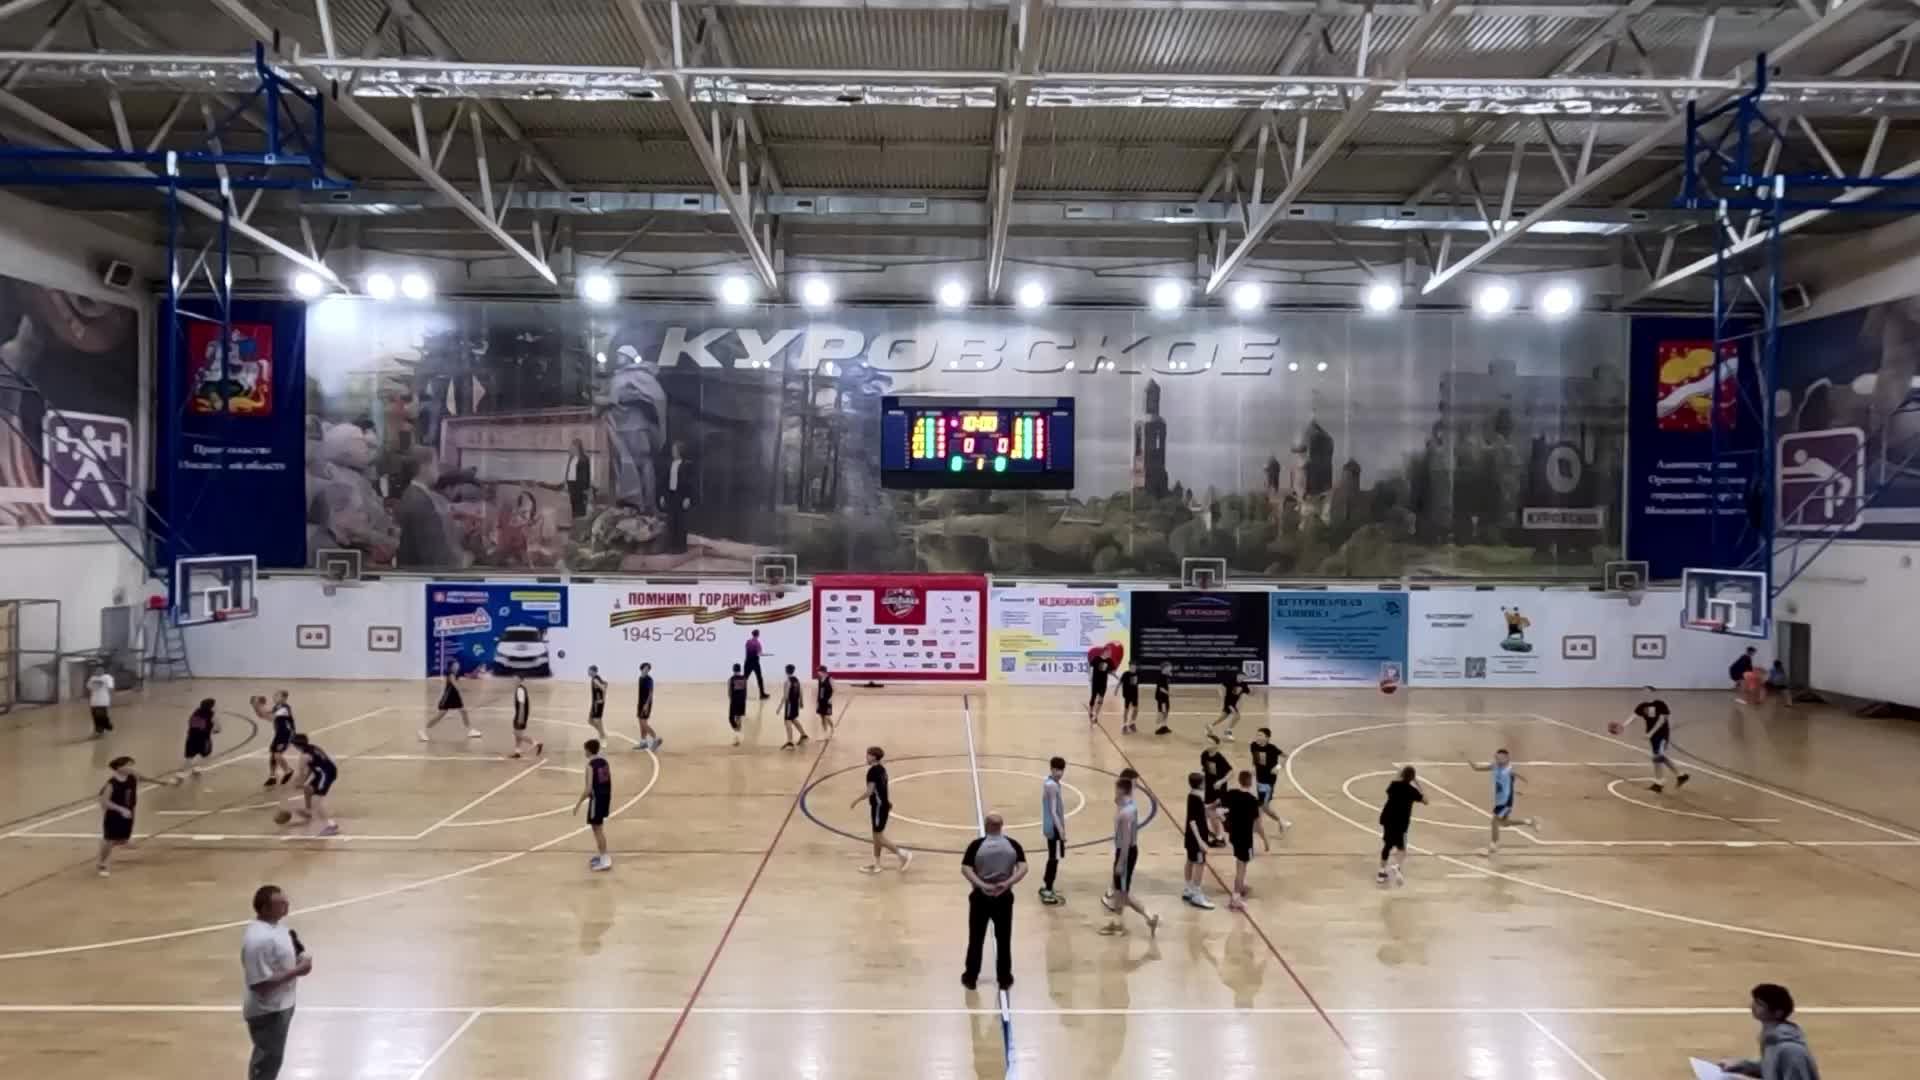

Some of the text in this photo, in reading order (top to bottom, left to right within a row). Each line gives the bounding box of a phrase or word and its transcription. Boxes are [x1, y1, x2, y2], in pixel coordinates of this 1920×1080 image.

[657, 326, 1281, 376] КУРОВСКОЕ
[628, 592, 772, 608] ПОМНИМ! ГОРДИМСЯ!
